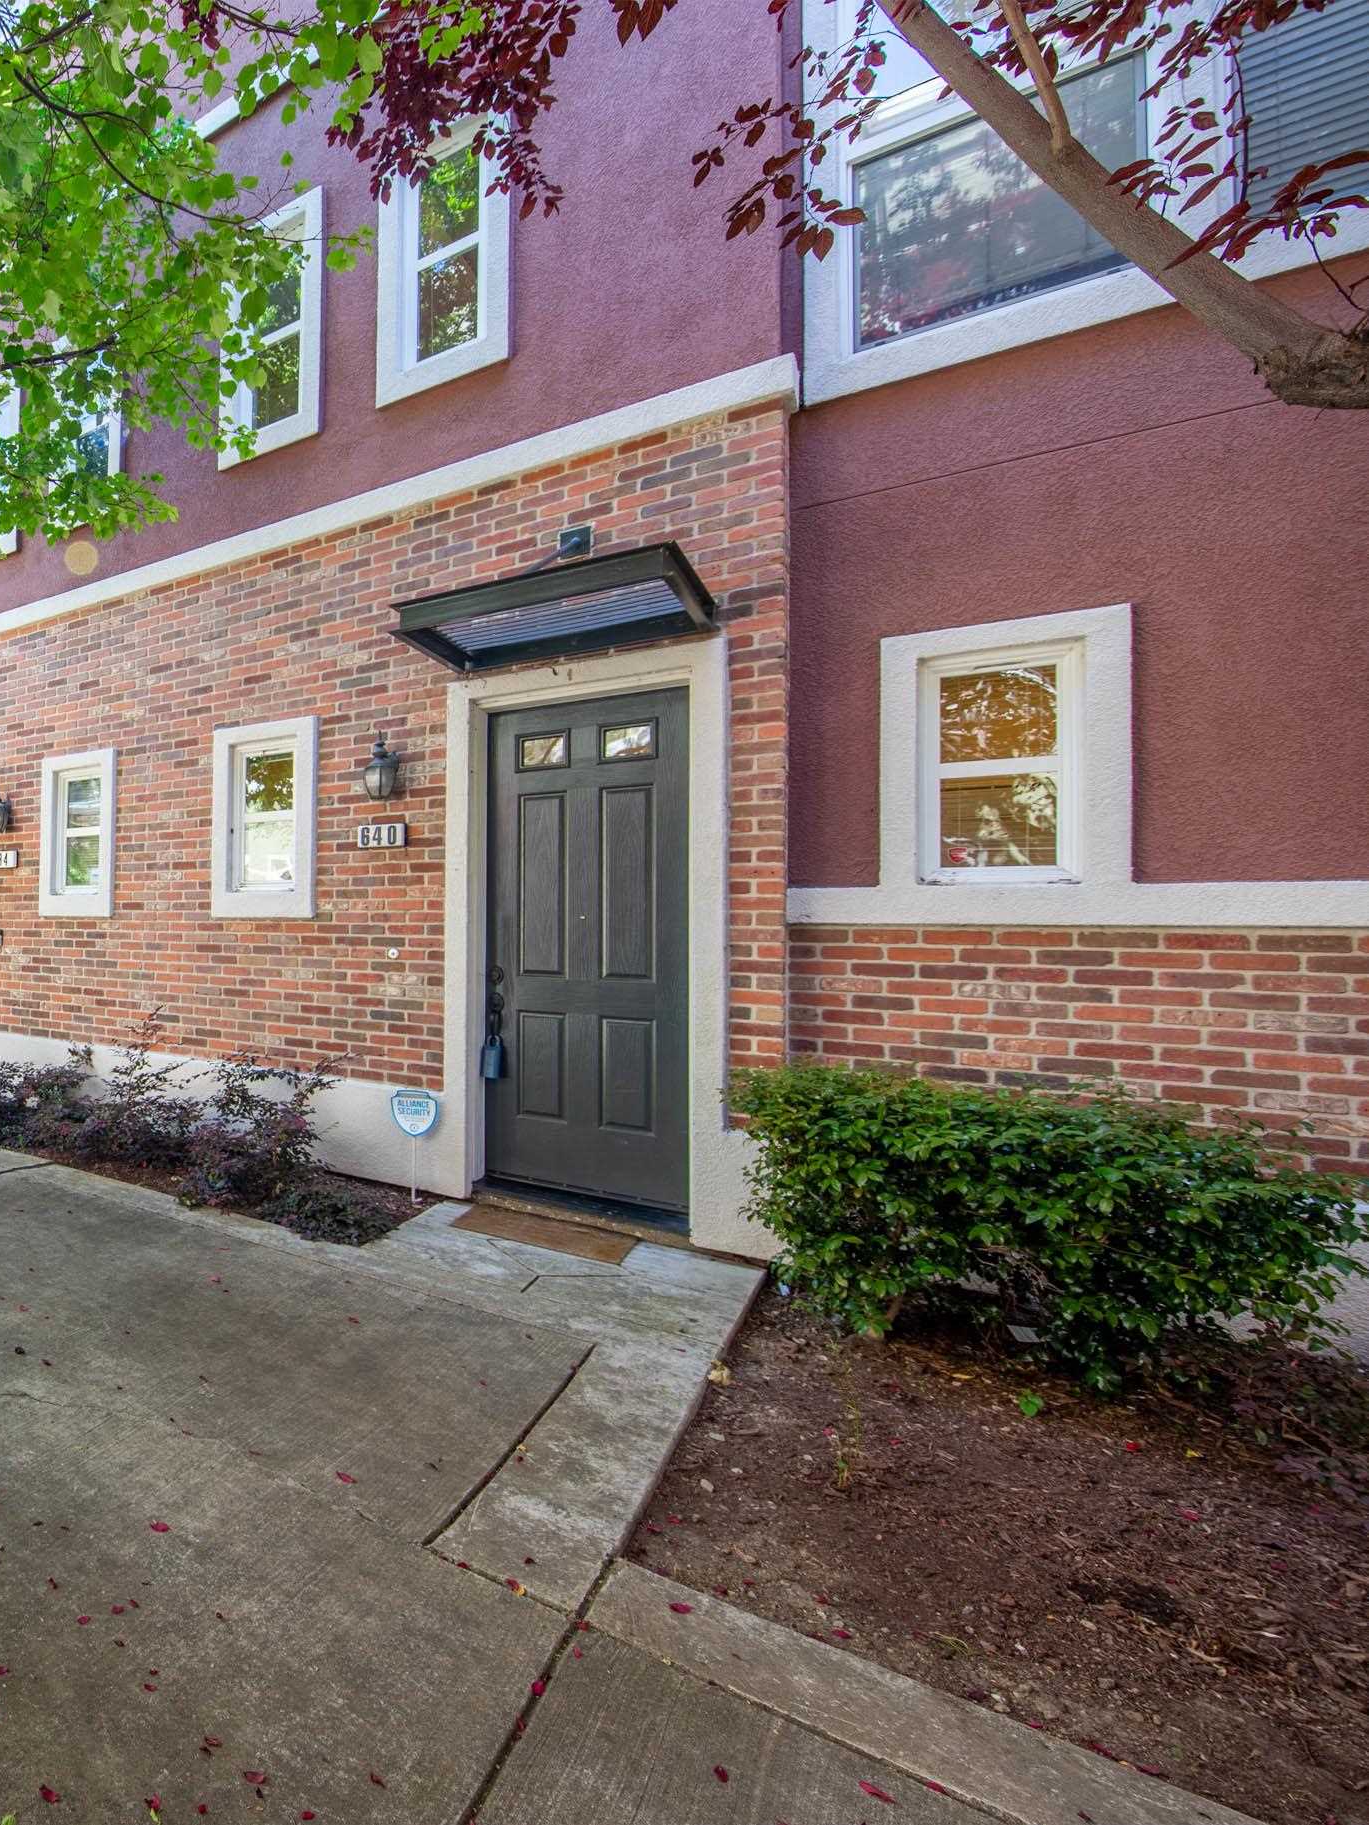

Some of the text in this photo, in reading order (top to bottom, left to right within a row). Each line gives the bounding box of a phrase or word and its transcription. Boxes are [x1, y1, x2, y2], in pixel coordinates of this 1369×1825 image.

[360, 825, 397, 846] 640
[397, 1099, 430, 1108] ALLIANCE
[397, 1107, 431, 1116] SECURITY
